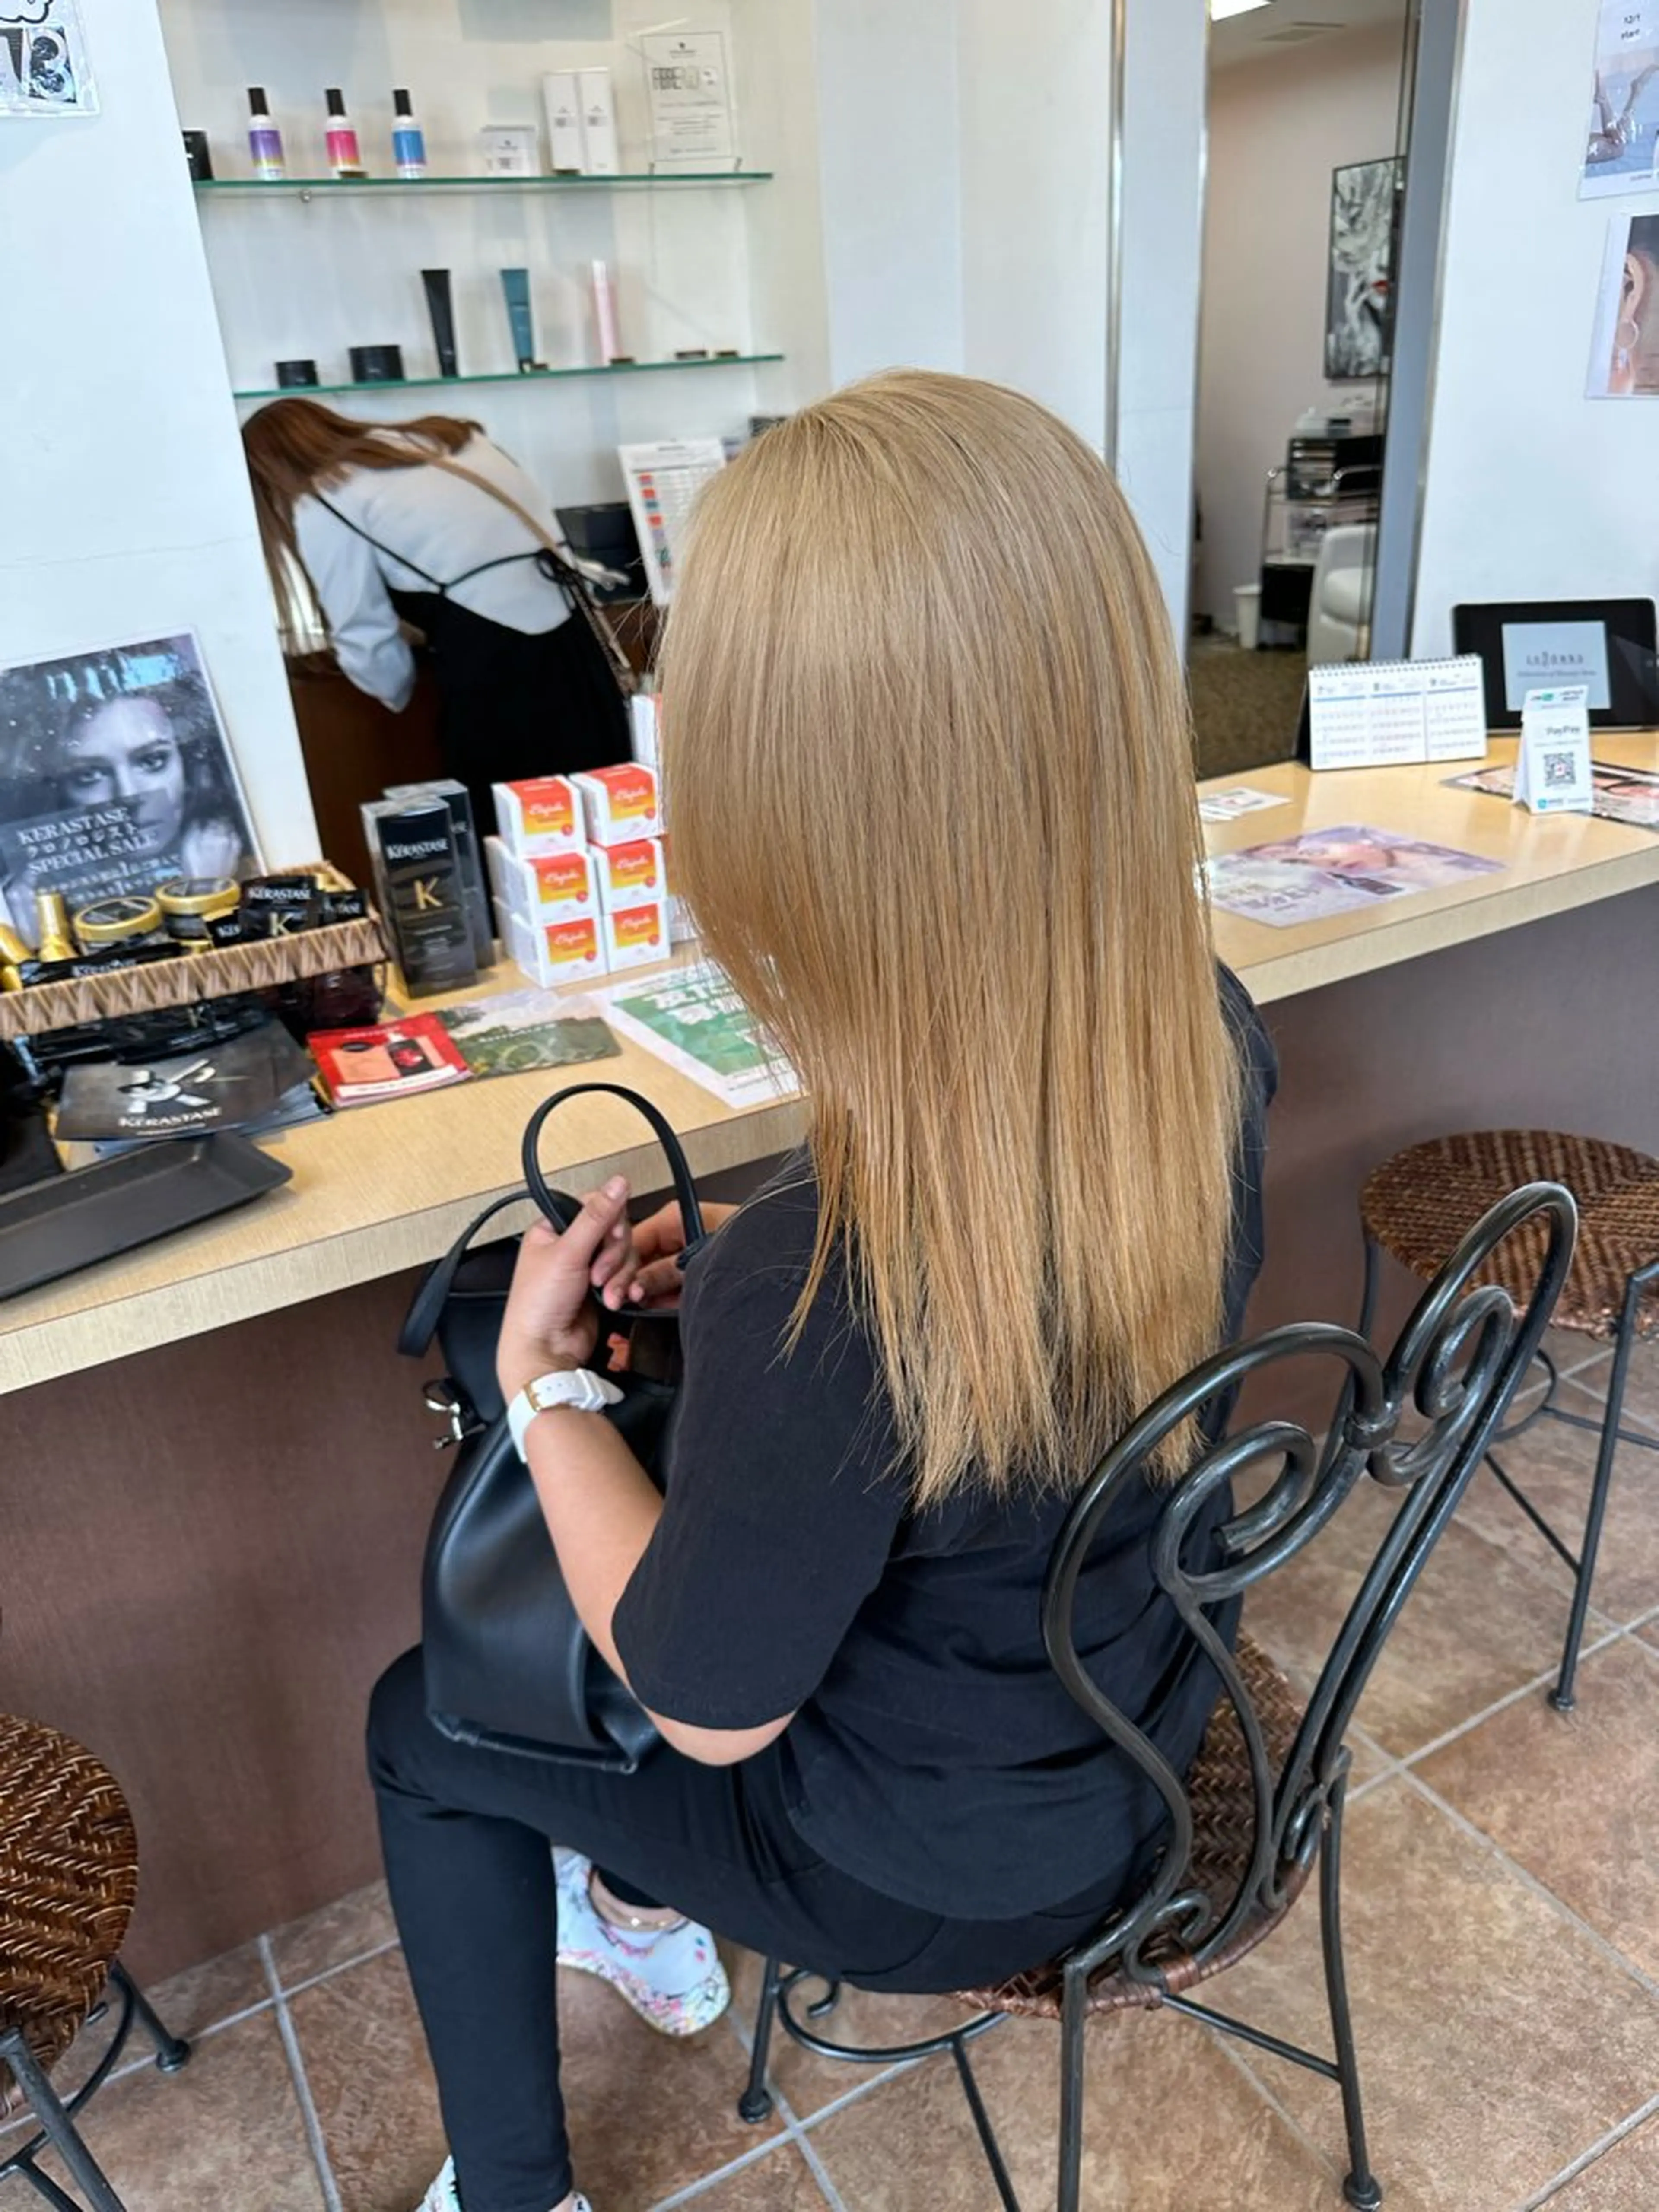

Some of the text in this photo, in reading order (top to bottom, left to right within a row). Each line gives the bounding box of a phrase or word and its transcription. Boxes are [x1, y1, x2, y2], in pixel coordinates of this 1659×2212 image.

[1545, 725, 1580, 736] PayPay
[16, 807, 131, 845] KERASTASE
[27, 845, 109, 876] SPECIAL
[108, 831, 159, 856] SALE
[414, 876, 443, 910] K
[270, 912, 302, 937] K
